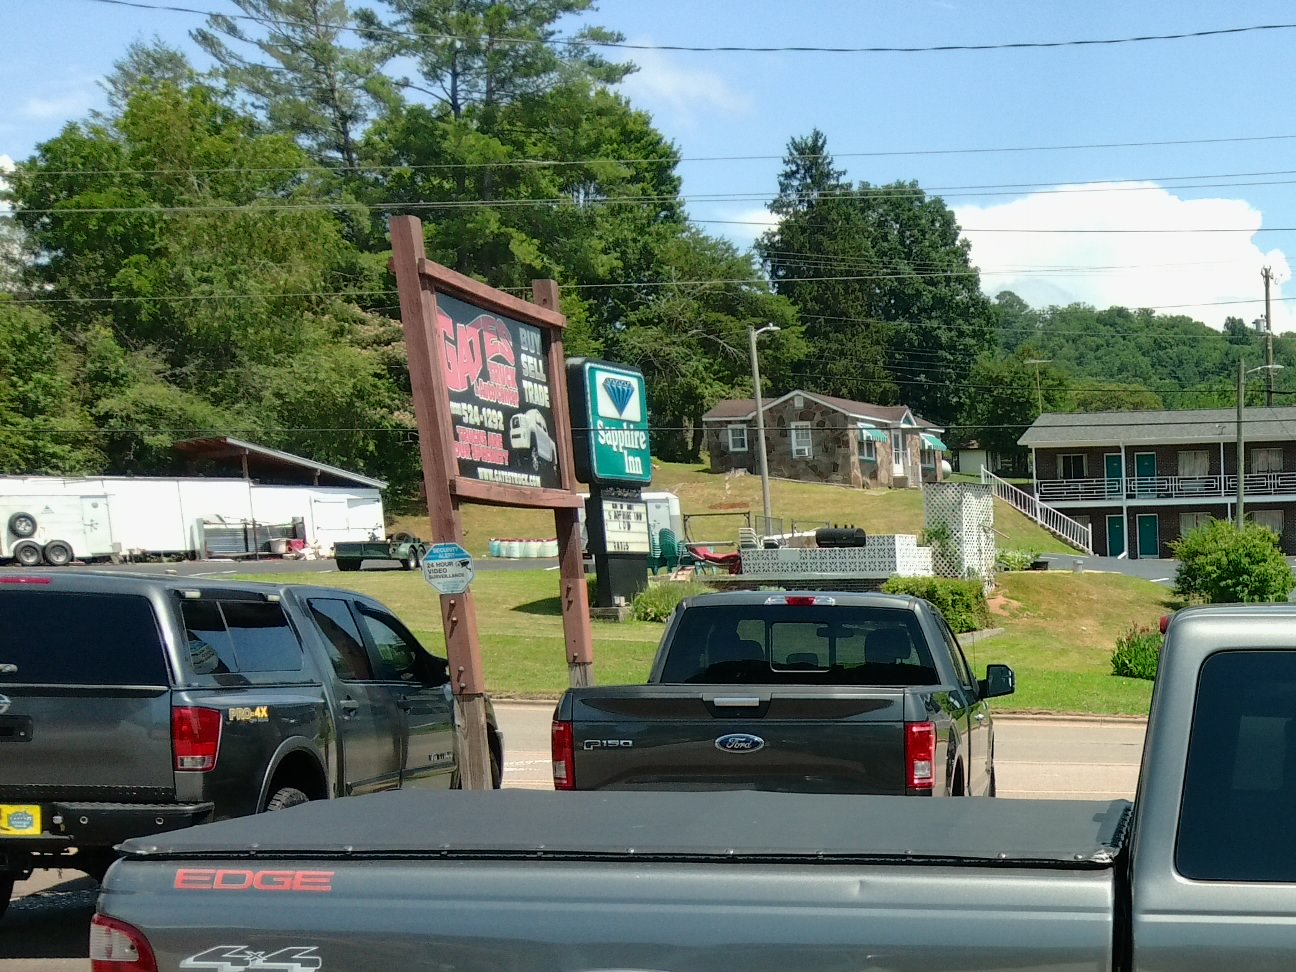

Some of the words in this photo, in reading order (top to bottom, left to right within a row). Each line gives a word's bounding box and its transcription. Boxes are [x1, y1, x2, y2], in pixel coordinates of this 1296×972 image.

[436, 305, 516, 392] GATES
[518, 326, 541, 356] BUY
[520, 353, 547, 382] SELL
[521, 379, 551, 409] TRADE
[460, 402, 505, 432] 524-1292
[597, 420, 647, 454] Sapphire
[623, 450, 643, 475] Inn
[428, 572, 465, 580] SURVEILLANCE
[725, 737, 753, 750] Ford
[173, 868, 336, 892] EDGE
